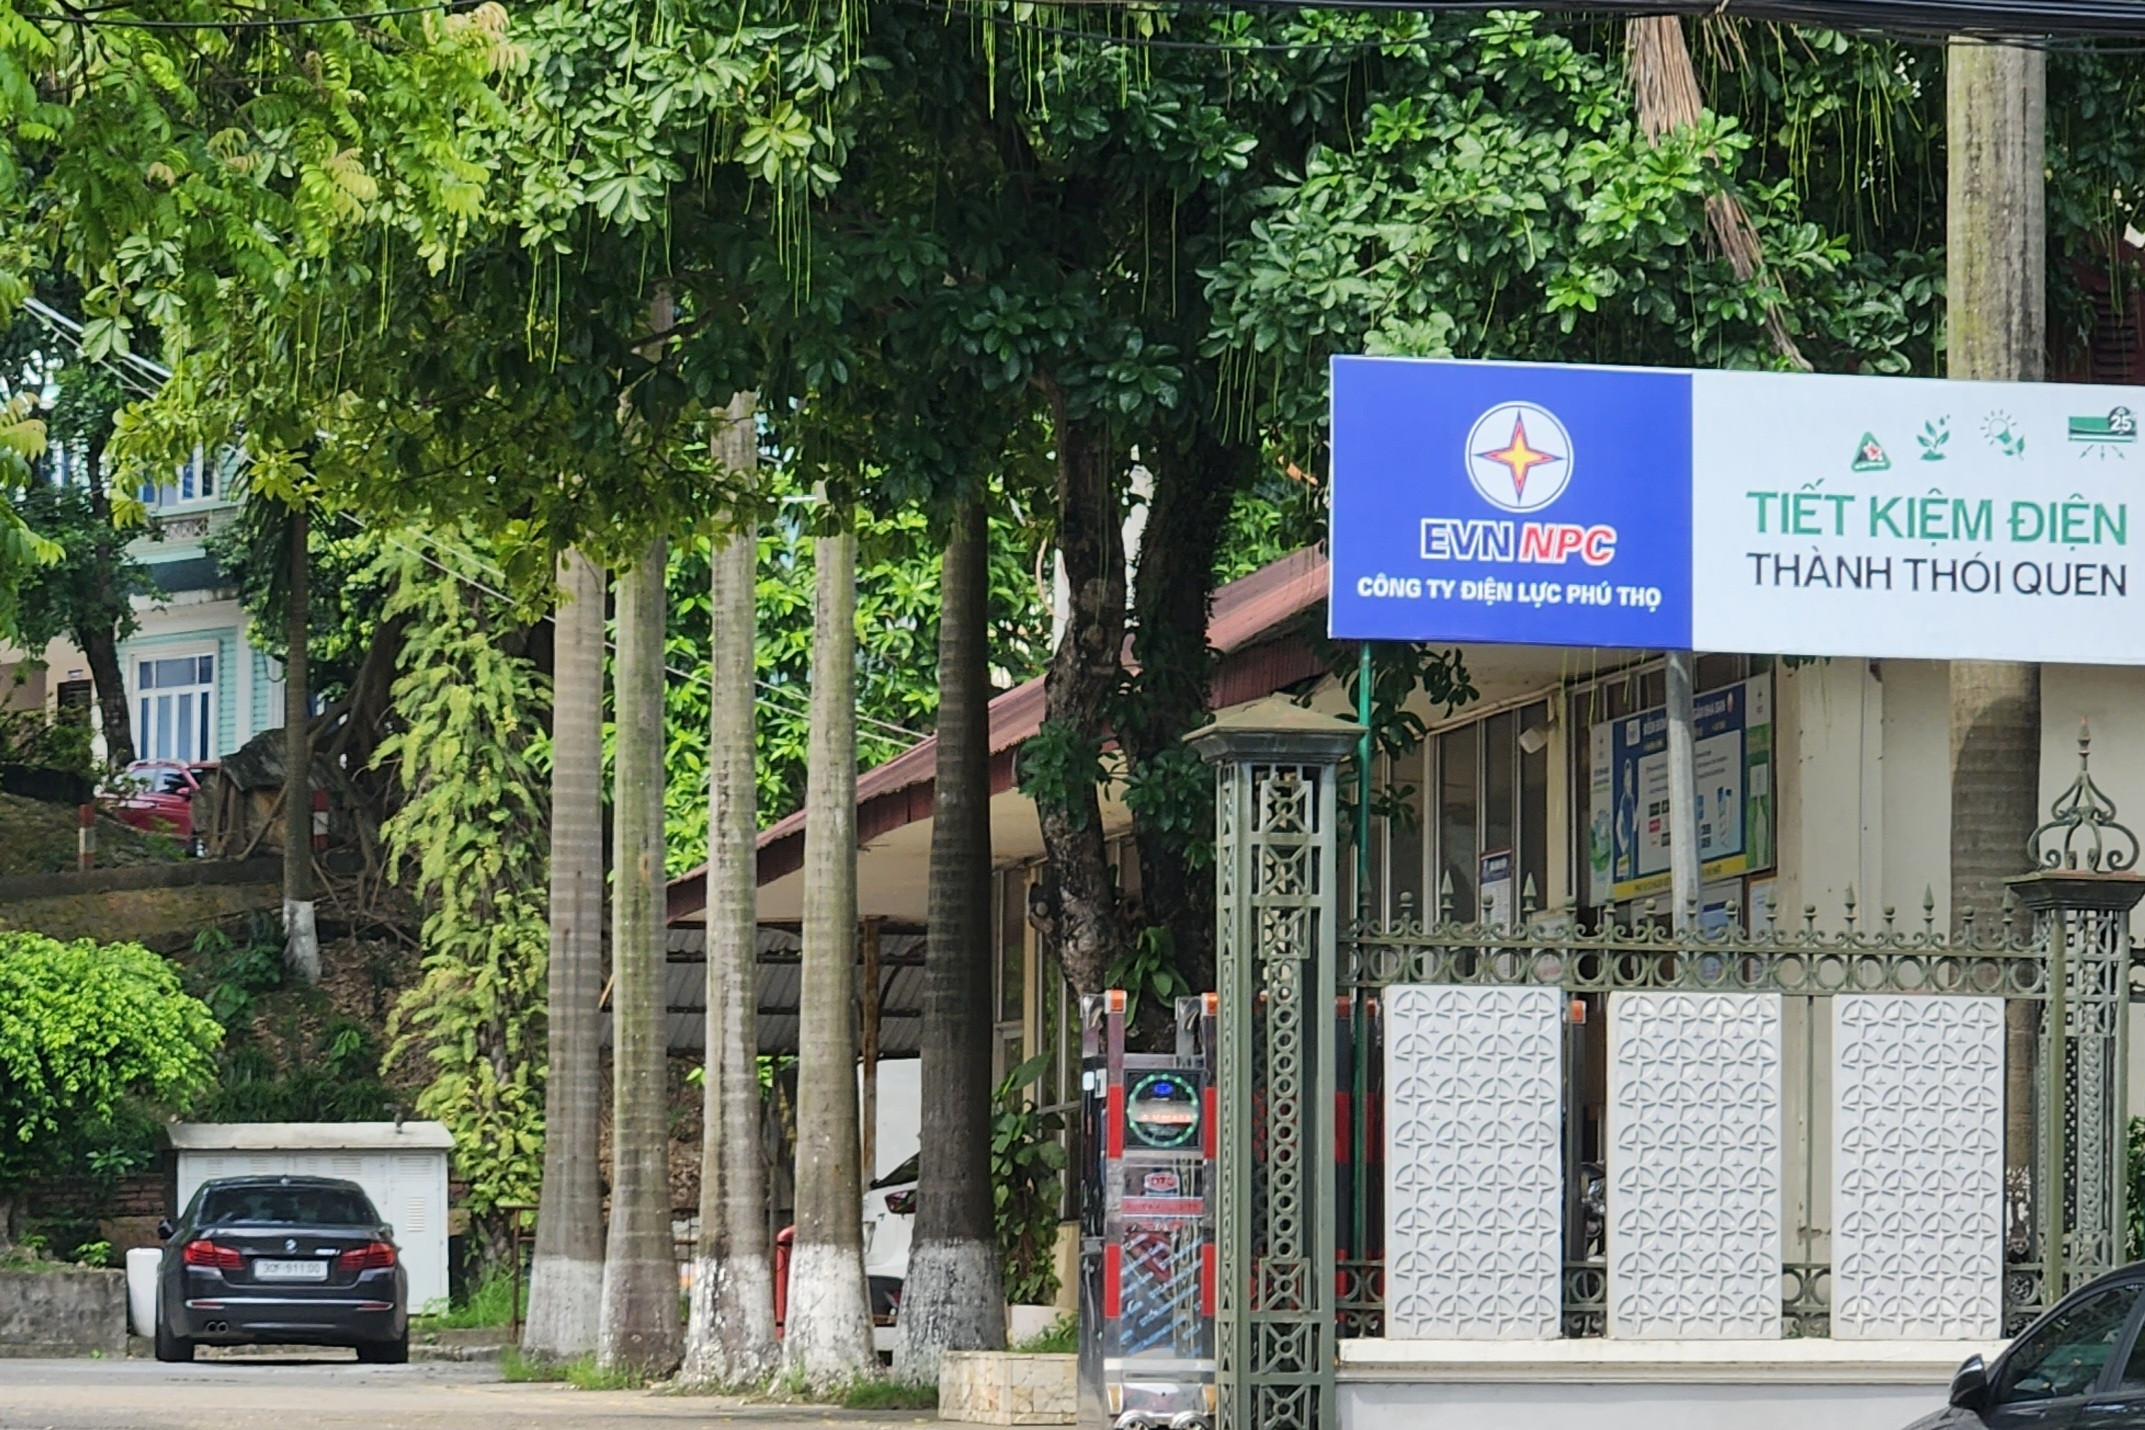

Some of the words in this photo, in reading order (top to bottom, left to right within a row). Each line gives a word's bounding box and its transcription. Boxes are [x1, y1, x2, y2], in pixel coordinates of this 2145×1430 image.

[1746, 478, 1855, 537] TIẾT
[1870, 488, 1992, 547] KIỆM
[2007, 493, 2127, 551] ĐIỆN
[1357, 573, 1421, 598] CÔNG
[1426, 580, 1456, 599] TY
[1460, 577, 1513, 606] ĐIỆN
[1517, 582, 1562, 608] LỰC
[1566, 581, 1612, 605] PHÚ
[1616, 586, 1662, 613] THỌ
[1746, 545, 1891, 590] THÀNH
[1903, 552, 2001, 595] THÓI
[2013, 561, 2127, 596] QUEN
